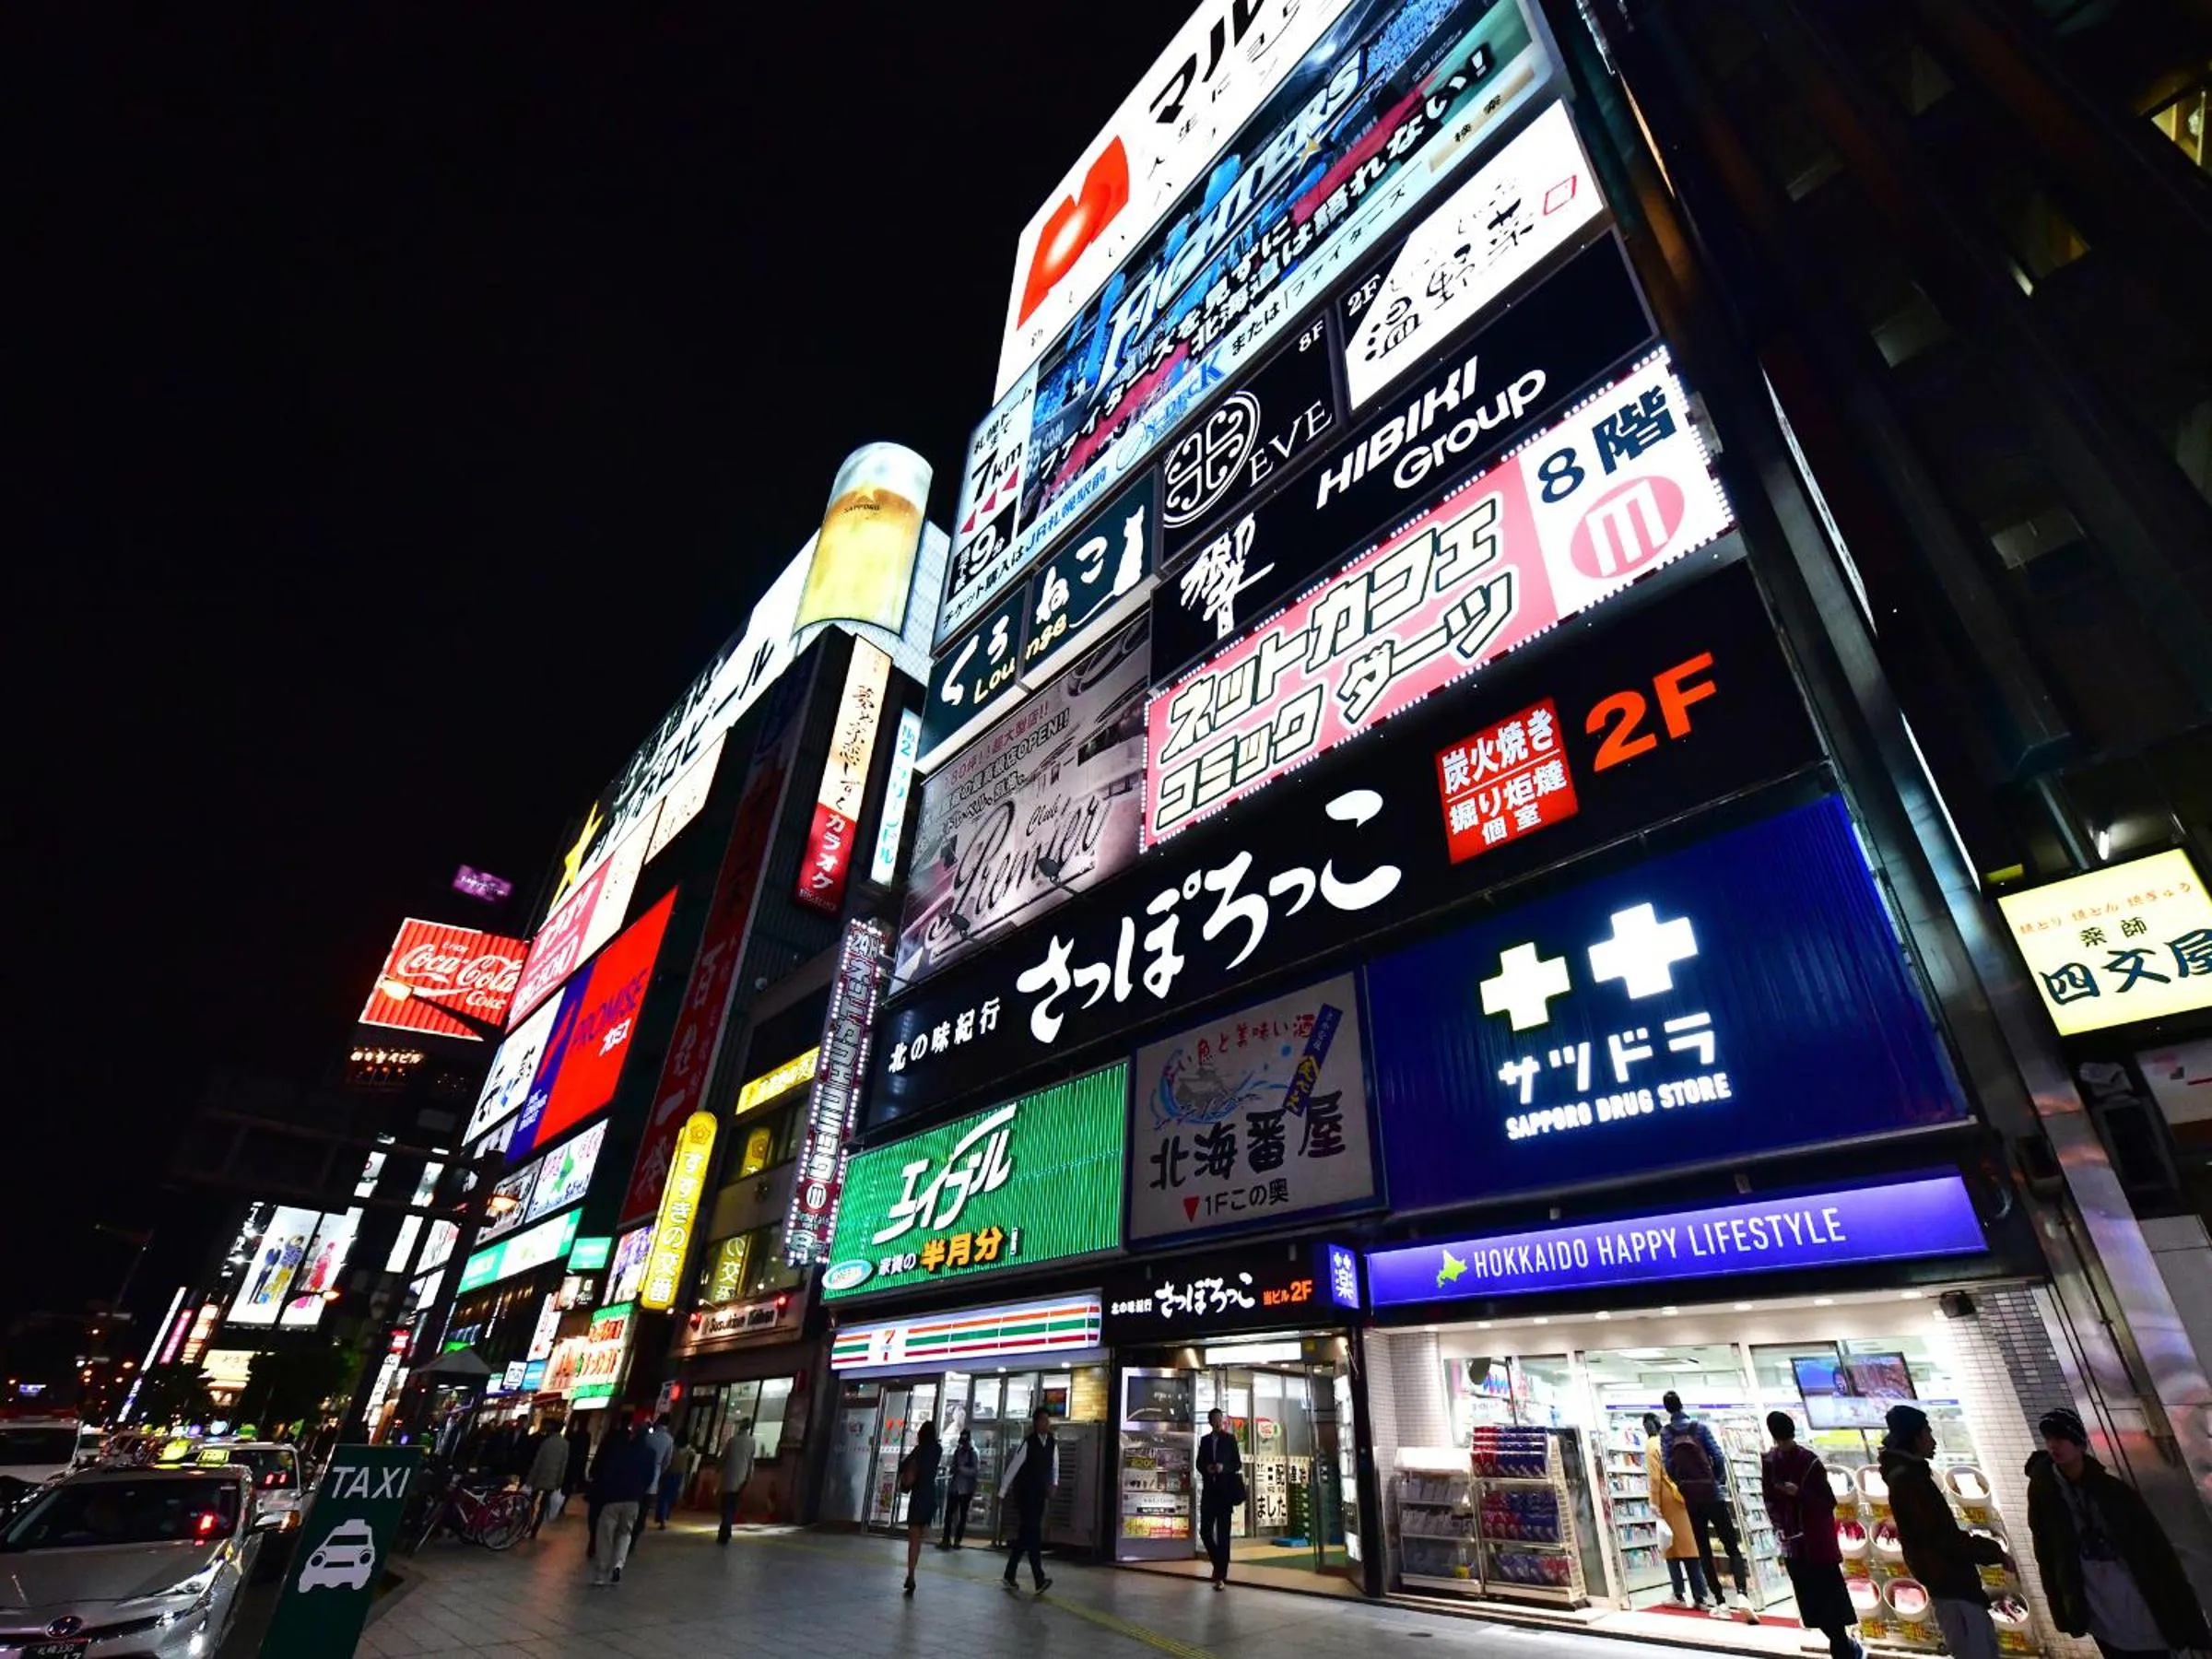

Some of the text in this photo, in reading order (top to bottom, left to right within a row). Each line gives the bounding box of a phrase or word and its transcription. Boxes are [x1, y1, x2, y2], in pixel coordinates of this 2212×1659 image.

[1088, 46, 1368, 409] FIGHTERS
[1232, 300, 1280, 356] または
[1347, 274, 1381, 317] 2F
[1041, 215, 1291, 479] ファイターズを見ずに
[1298, 319, 1324, 353] 8F
[1249, 400, 1333, 488] EVE
[1316, 355, 1478, 511] HIBIKI
[1393, 370, 1547, 490] Group
[1537, 383, 1679, 505] 8階
[1154, 683, 1325, 832] コミック
[1337, 571, 1513, 727] ダーツ
[1584, 651, 1719, 774] 2F
[1441, 708, 1555, 796] 炭火焼き
[1448, 759, 1569, 836] 掘り炬燵
[1480, 803, 1543, 847] 個室
[811, 813, 847, 889] カラオケ
[1016, 790, 1402, 1043] さっぽろっこ
[397, 944, 524, 993] Coca-Cola
[466, 990, 506, 1010] Coke
[888, 995, 1002, 1075] 北の味紀行
[1498, 1011, 1717, 1106] サツドラ
[1149, 1089, 1346, 1191] 北海番屋
[1505, 1072, 1733, 1141] SAPPORO DRUG STORE
[648, 1153, 702, 1302] すすきの交番
[1205, 1178, 1289, 1218] 1Fこの奥
[1473, 1206, 1847, 1279] HOKKAIDO HAPPY LIFESTYLE
[1155, 1272, 1255, 1319] さっぽろっこ
[332, 1465, 413, 1500] TAXI
